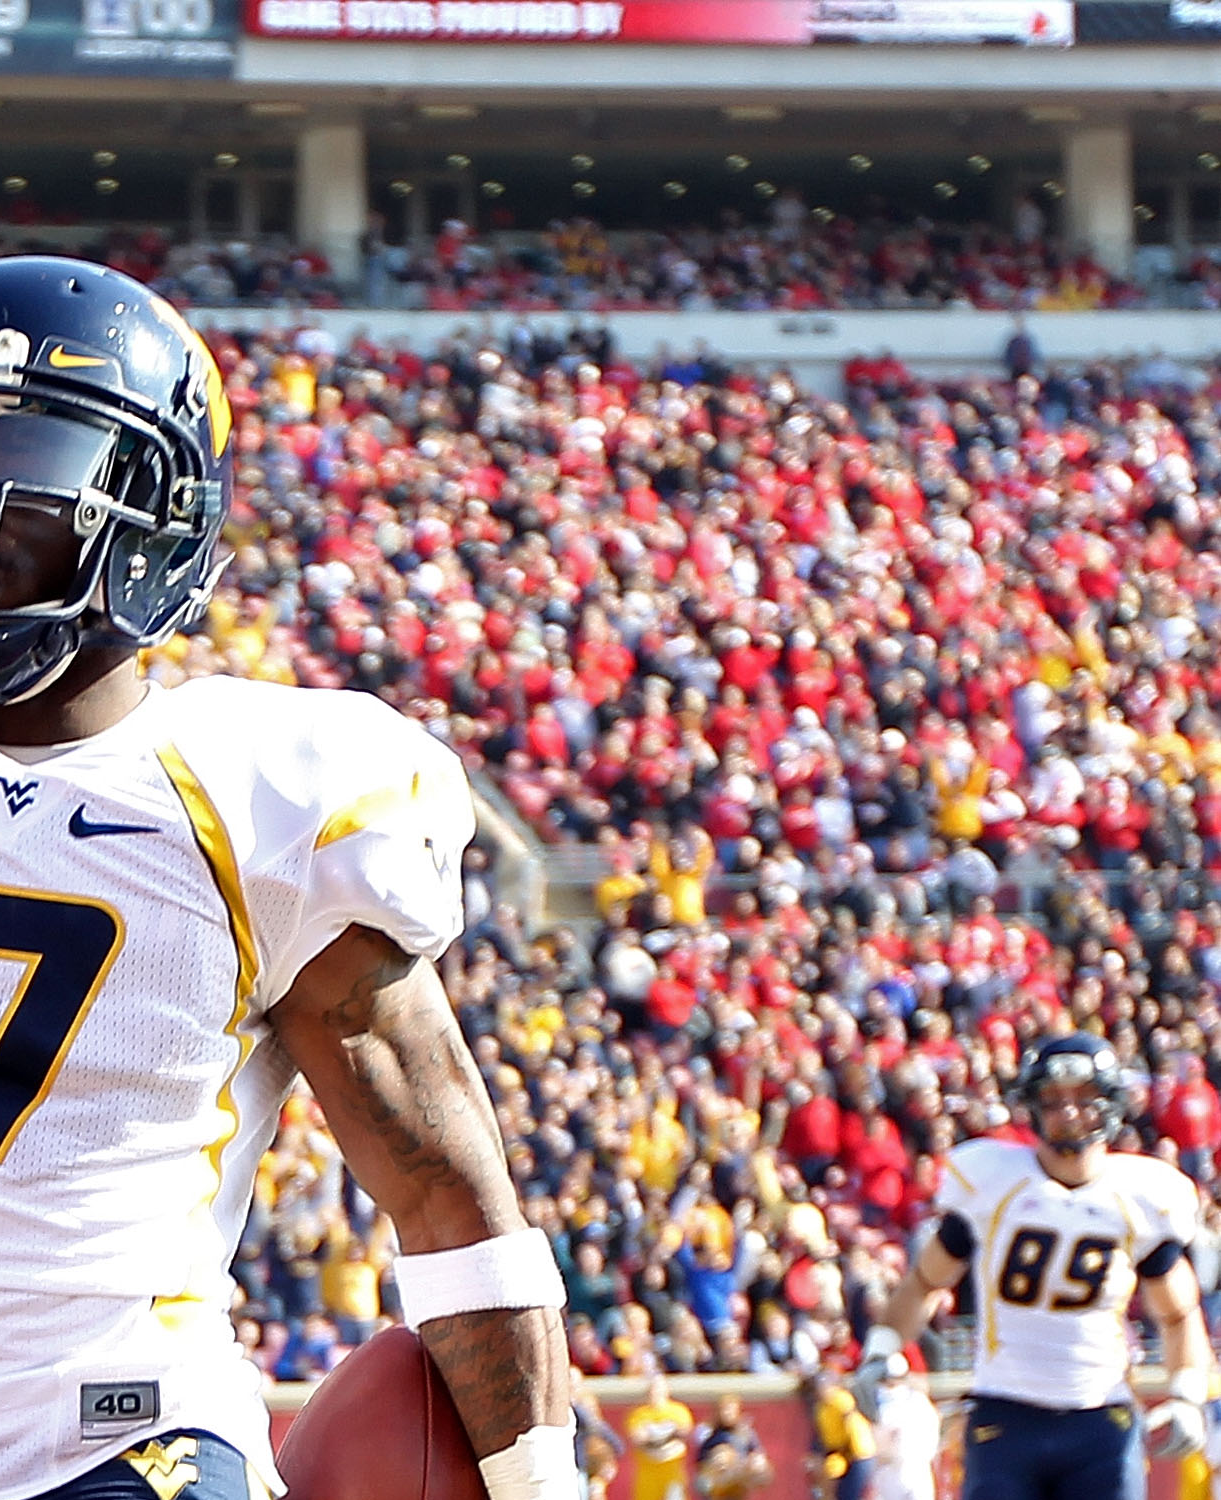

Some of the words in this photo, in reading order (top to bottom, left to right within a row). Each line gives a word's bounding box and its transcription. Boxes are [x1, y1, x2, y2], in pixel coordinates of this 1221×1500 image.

[346, 2, 434, 33] STATS
[437, 2, 577, 35] PROVIDED
[581, 3, 621, 36] BY
[999, 1226, 1119, 1311] 89
[94, 1393, 142, 1416] 40
